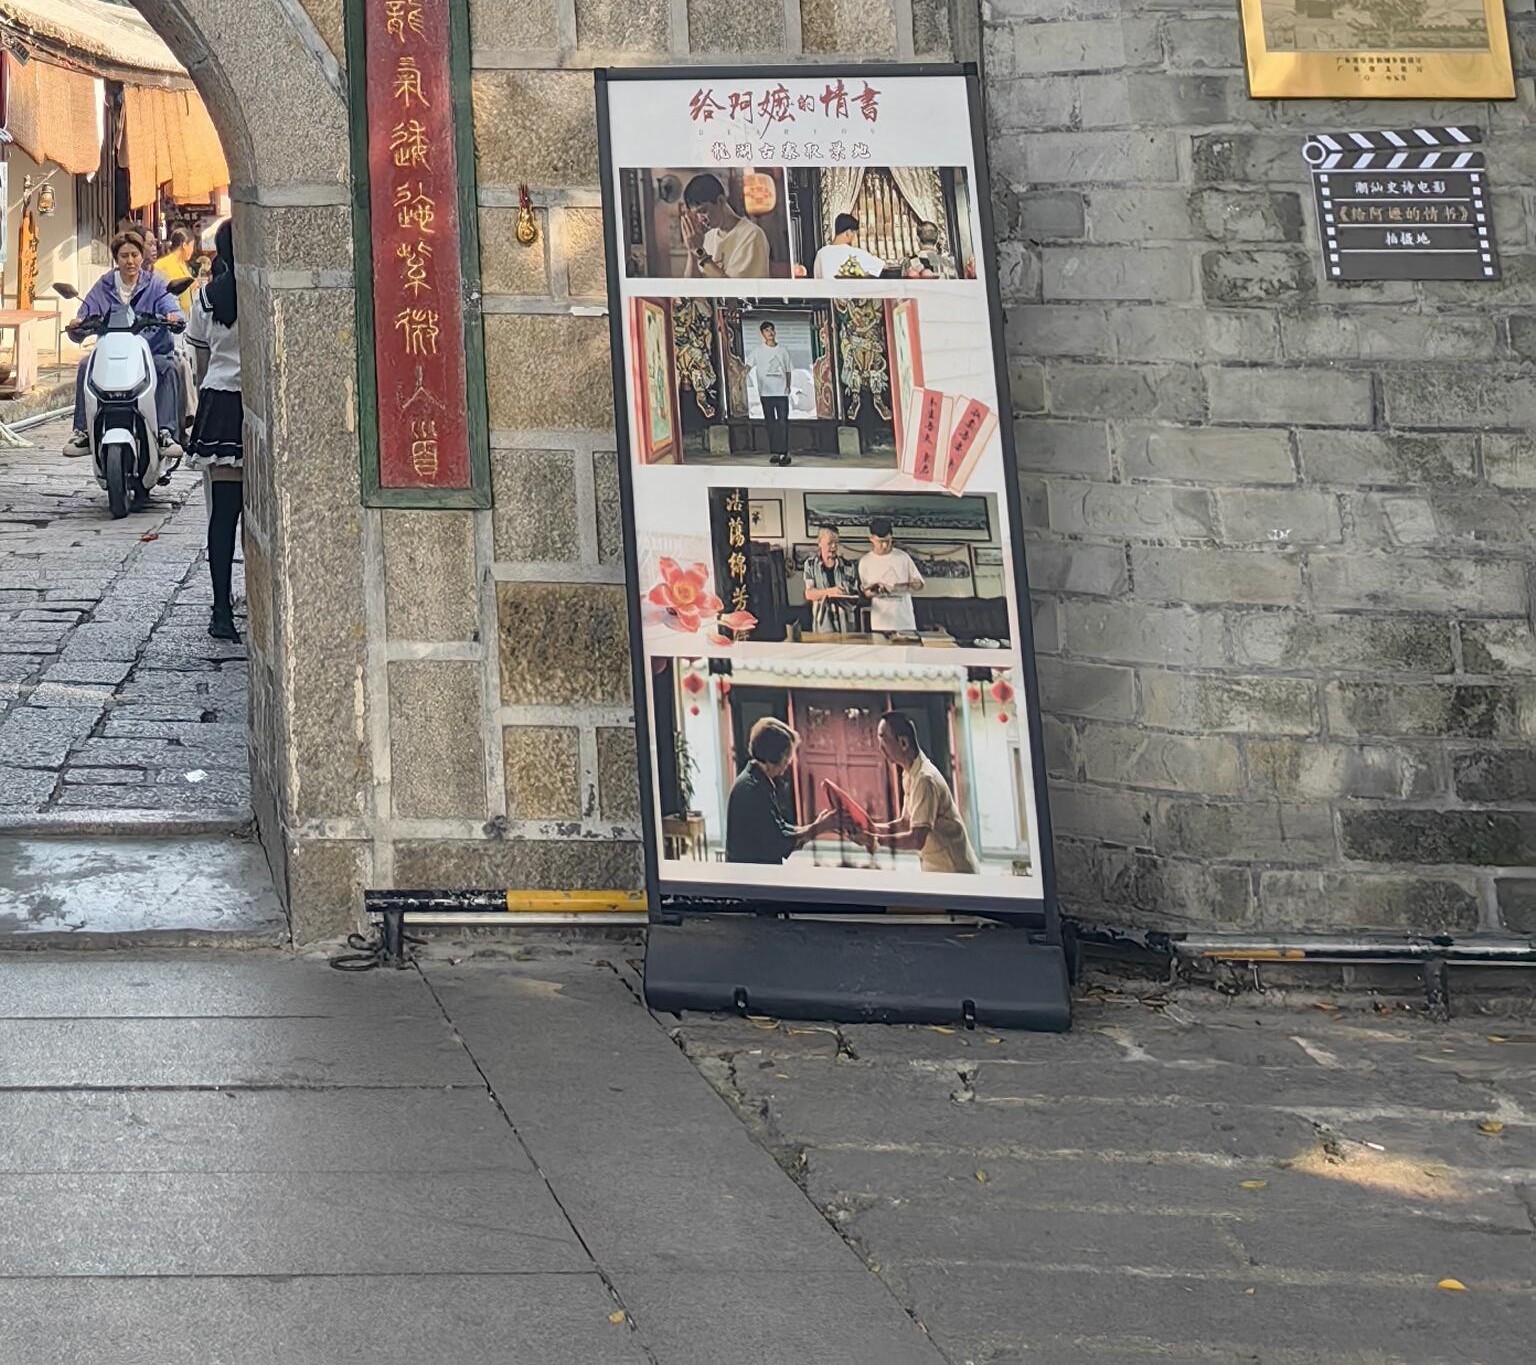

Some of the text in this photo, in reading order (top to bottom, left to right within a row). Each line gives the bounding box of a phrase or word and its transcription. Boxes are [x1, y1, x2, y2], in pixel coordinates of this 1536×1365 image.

[1355, 180, 1446, 195] 潮汕史诗电影
[1385, 231, 1431, 246] 拍摄地
